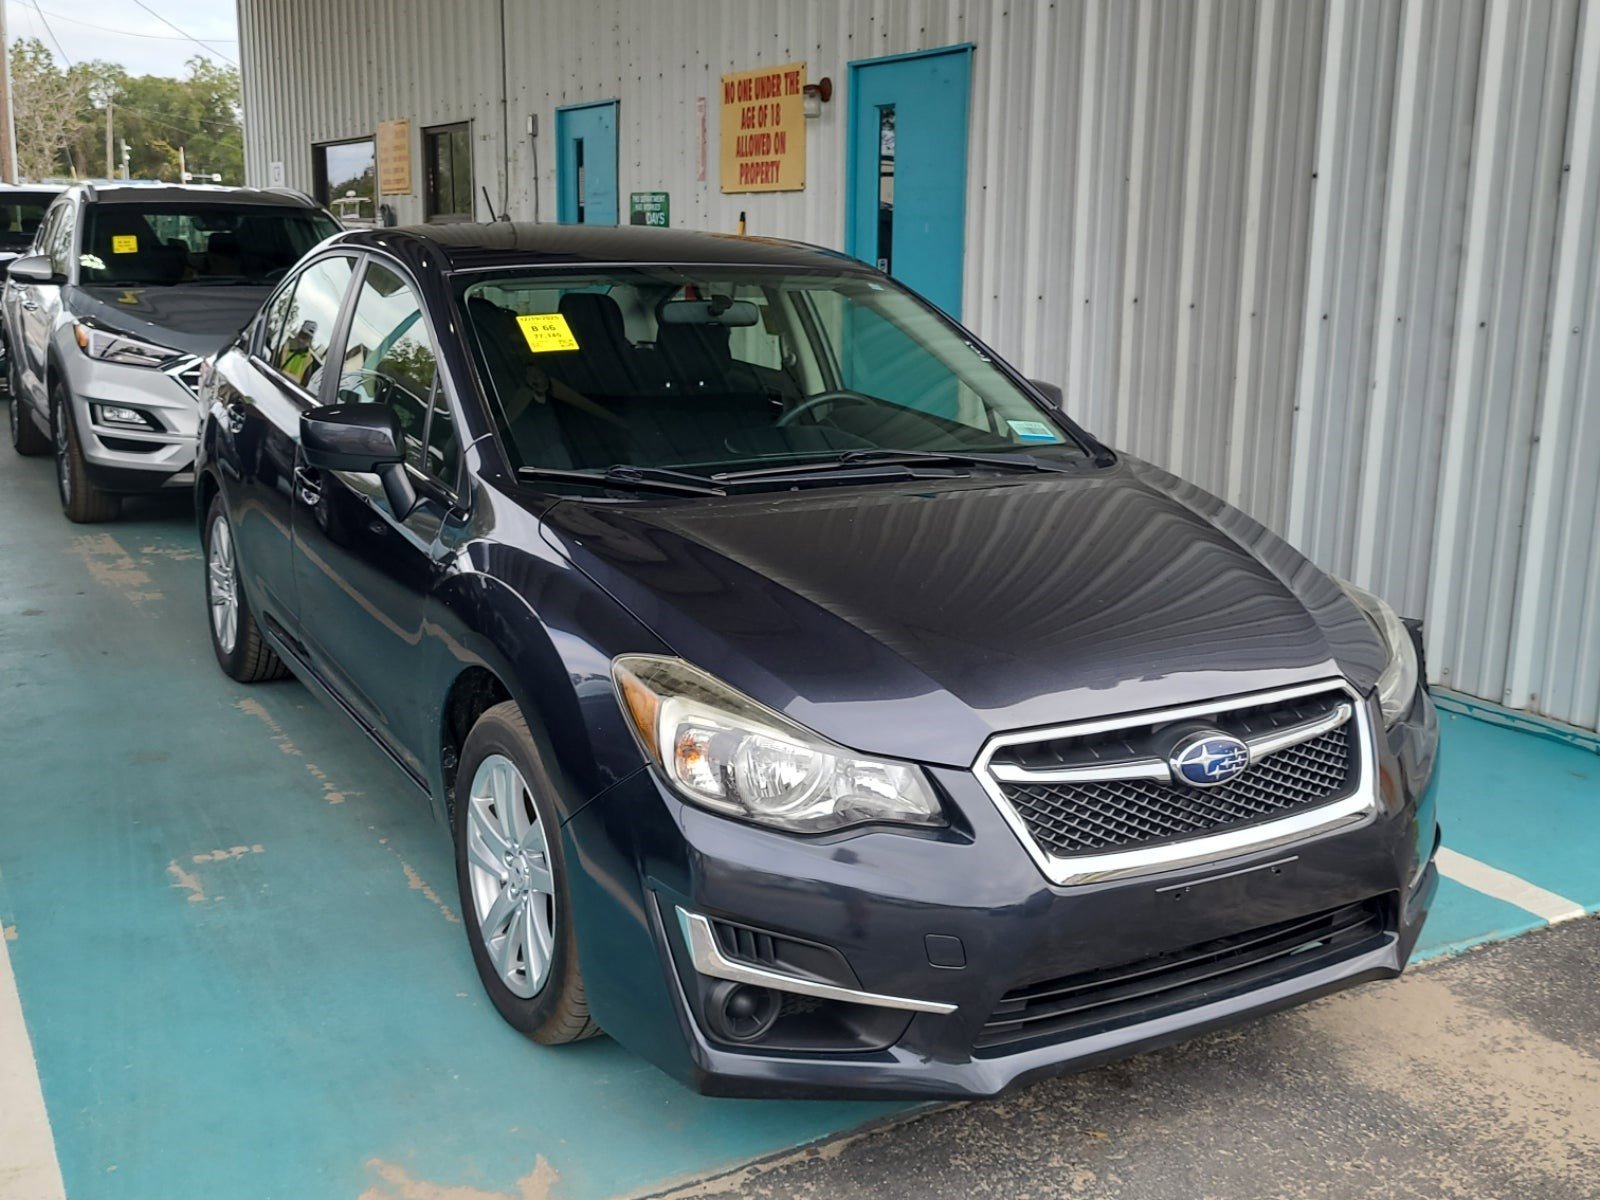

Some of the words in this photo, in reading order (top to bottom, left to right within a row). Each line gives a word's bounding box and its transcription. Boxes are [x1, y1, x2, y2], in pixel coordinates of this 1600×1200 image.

[724, 81, 735, 104] NO
[737, 78, 752, 102] ONE
[754, 73, 782, 100] UNDER
[785, 71, 800, 95] THE
[741, 107, 755, 129] AGE
[758, 105, 768, 128] OF
[771, 103, 781, 127] 18
[736, 133, 771, 157] ALLOWED
[774, 132, 786, 154] ON
[739, 161, 781, 185] PROPERTY
[646, 212, 665, 225] DAYS
